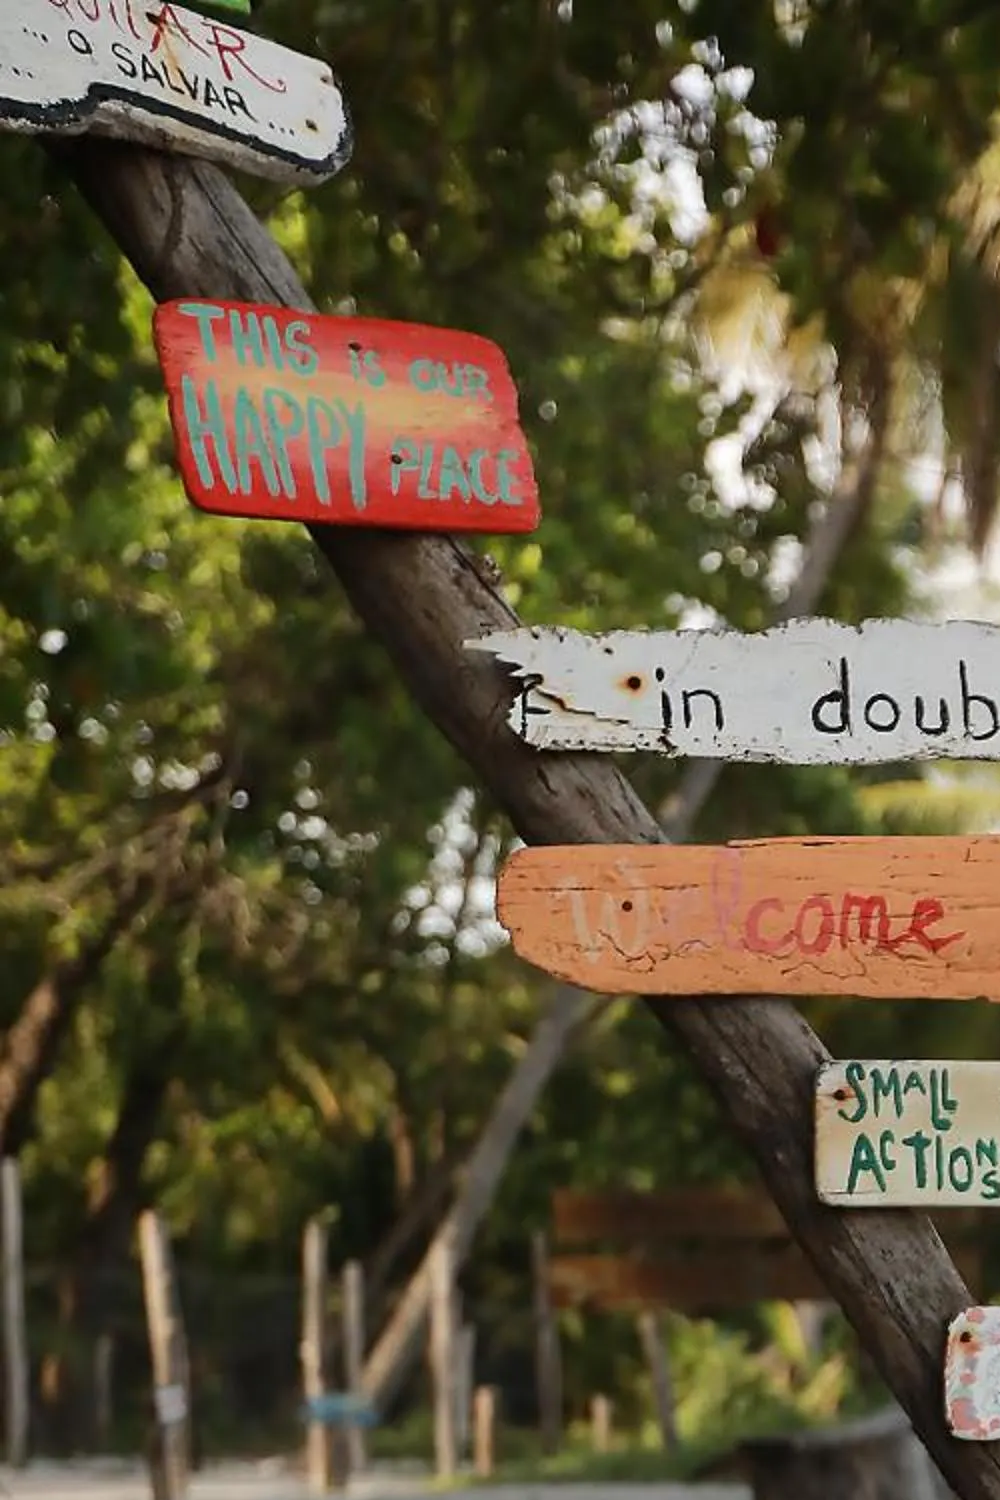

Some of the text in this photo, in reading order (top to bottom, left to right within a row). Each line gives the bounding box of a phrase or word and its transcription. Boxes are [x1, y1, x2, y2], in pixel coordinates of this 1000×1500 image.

[179, 303, 318, 376] THIS
[410, 358, 494, 402] OUR
[180, 374, 525, 509] HAPPY PLACE
[655, 667, 724, 734] in
[838, 1061, 959, 1132] SMALL
